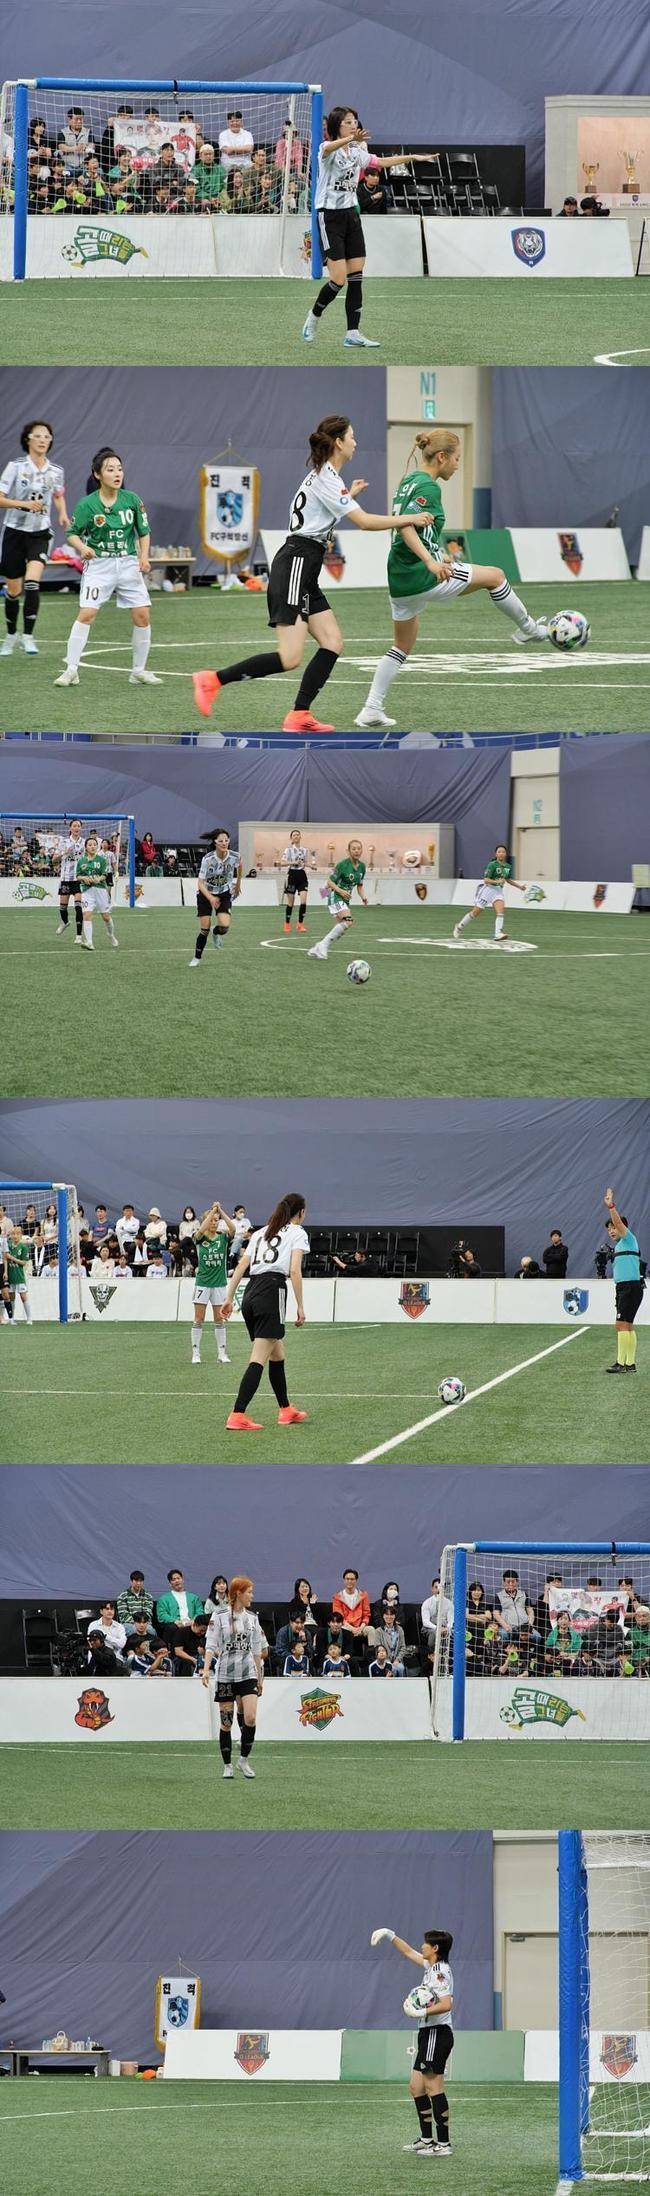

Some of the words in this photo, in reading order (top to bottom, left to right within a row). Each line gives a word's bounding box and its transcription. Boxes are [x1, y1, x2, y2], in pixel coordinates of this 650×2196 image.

[420, 371, 437, 396] N1
[210, 474, 220, 488] 진
[118, 509, 134, 526] 10
[109, 529, 124, 539] FC
[85, 586, 100, 601] 10
[215, 1240, 221, 1248] 7
[252, 1235, 282, 1266] 18
[197, 1290, 204, 1299] 7
[219, 1684, 233, 1697] 21
[162, 1983, 171, 1995] 진
